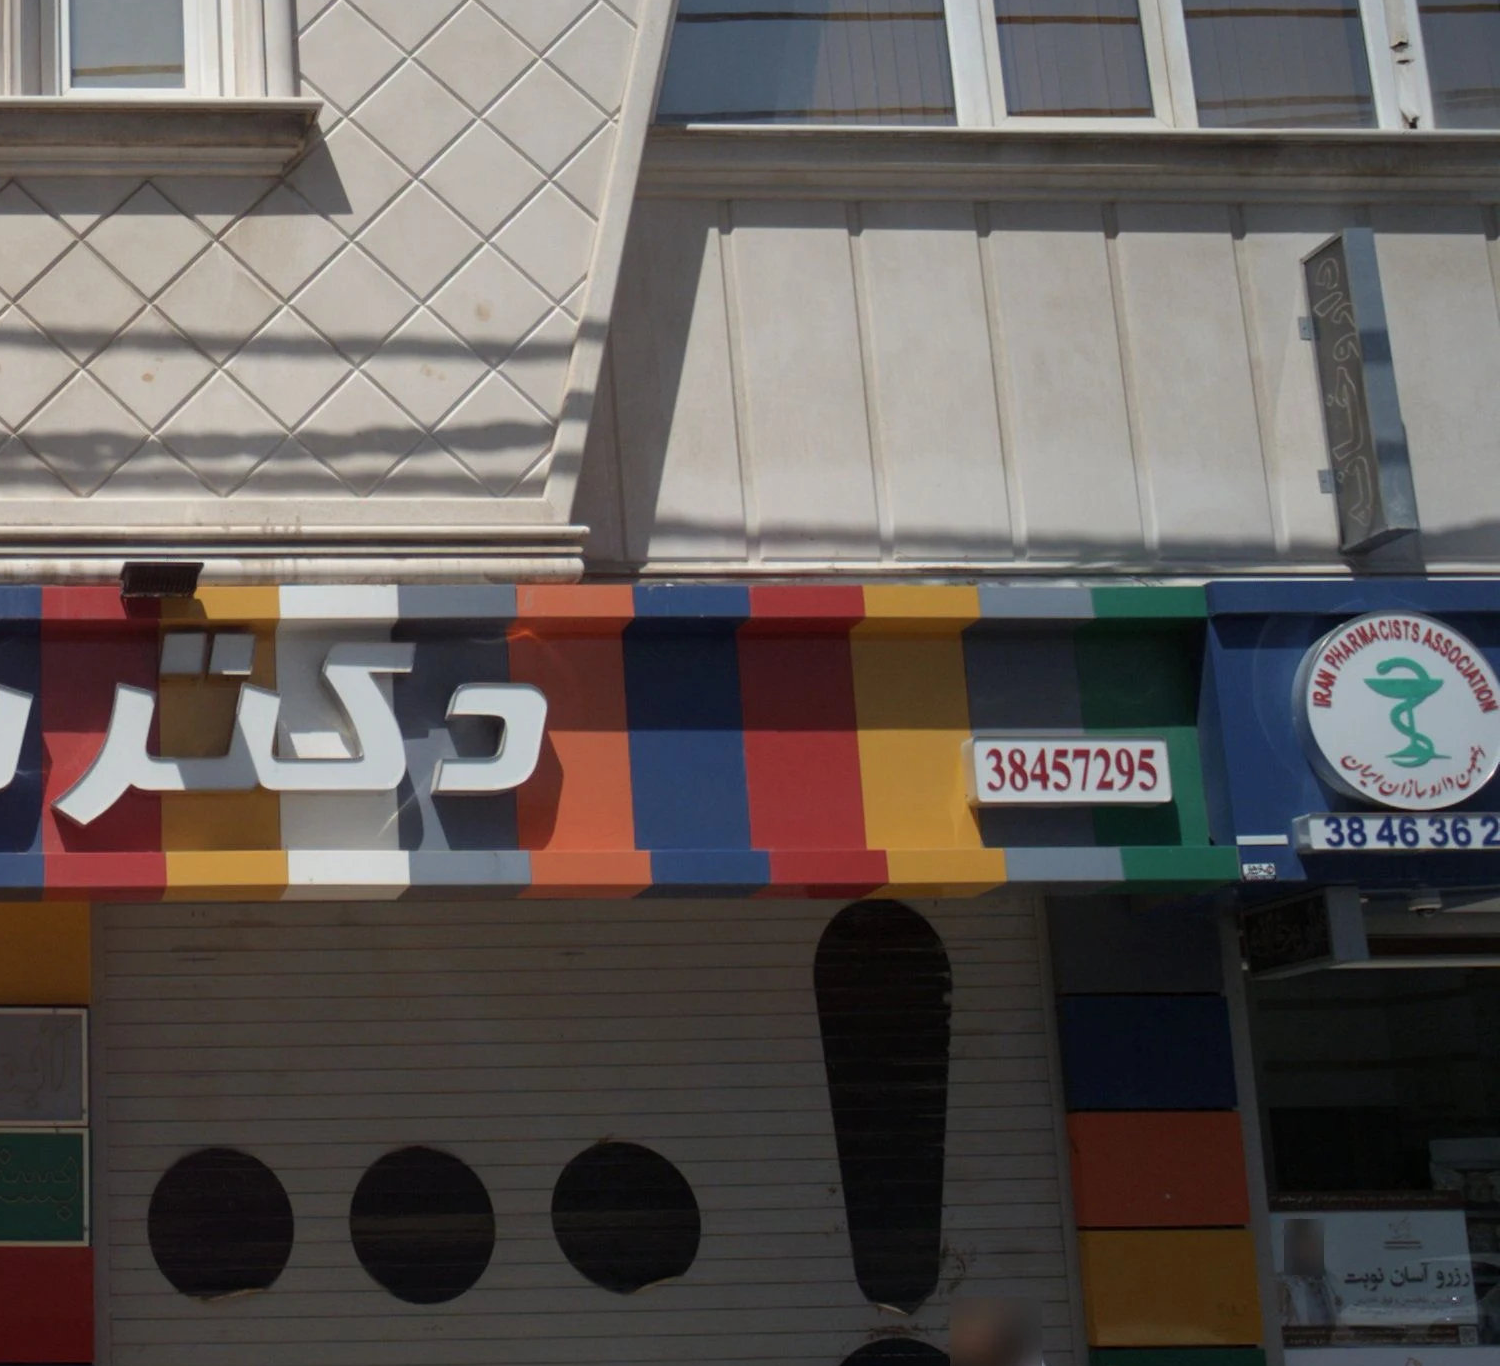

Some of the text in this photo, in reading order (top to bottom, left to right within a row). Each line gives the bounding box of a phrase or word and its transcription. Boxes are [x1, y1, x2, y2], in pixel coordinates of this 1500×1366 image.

[1313, 619, 1499, 715] IRAN PHARMACISTS ASSOCIATION
[51, 631, 550, 828] دکتر
[985, 747, 1159, 793] 38457295
[1339, 754, 1384, 789] ایران
[1324, 816, 1367, 848] 38
[1376, 816, 1420, 848] 46
[1428, 816, 1472, 848] 36
[1343, 1262, 1471, 1292] رزرو آسان نوبت
